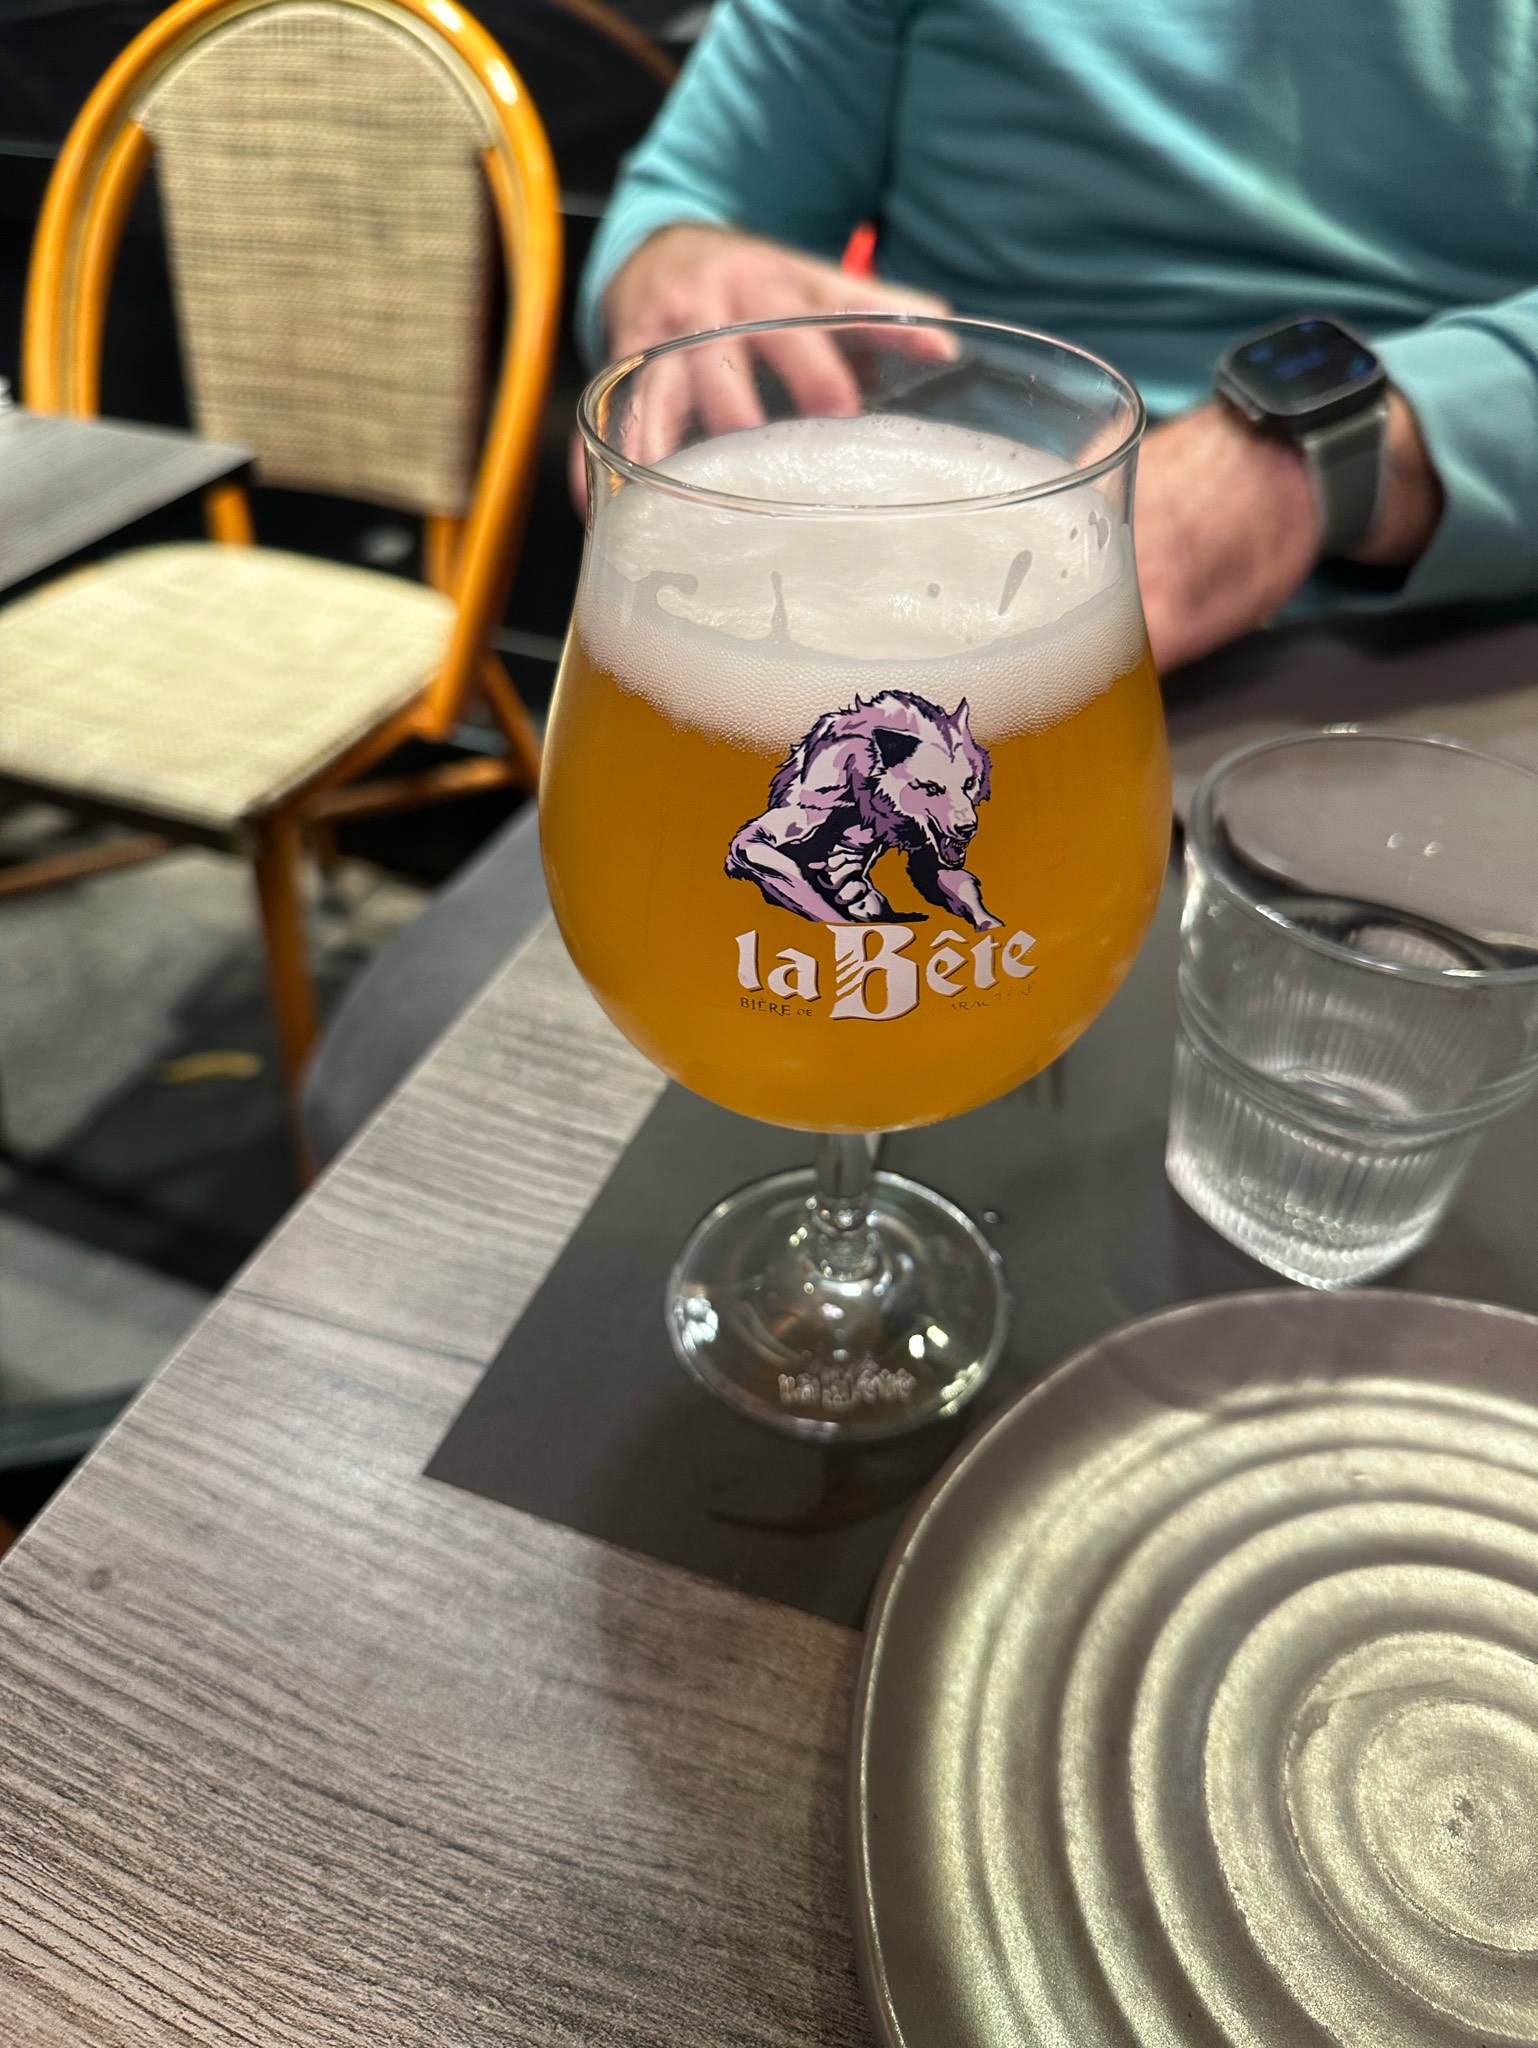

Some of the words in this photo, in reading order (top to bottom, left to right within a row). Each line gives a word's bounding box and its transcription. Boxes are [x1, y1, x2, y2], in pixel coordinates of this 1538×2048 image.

[735, 930, 822, 1002] la
[826, 924, 1039, 1022] Bête
[740, 997, 791, 1016] BIÈRE
